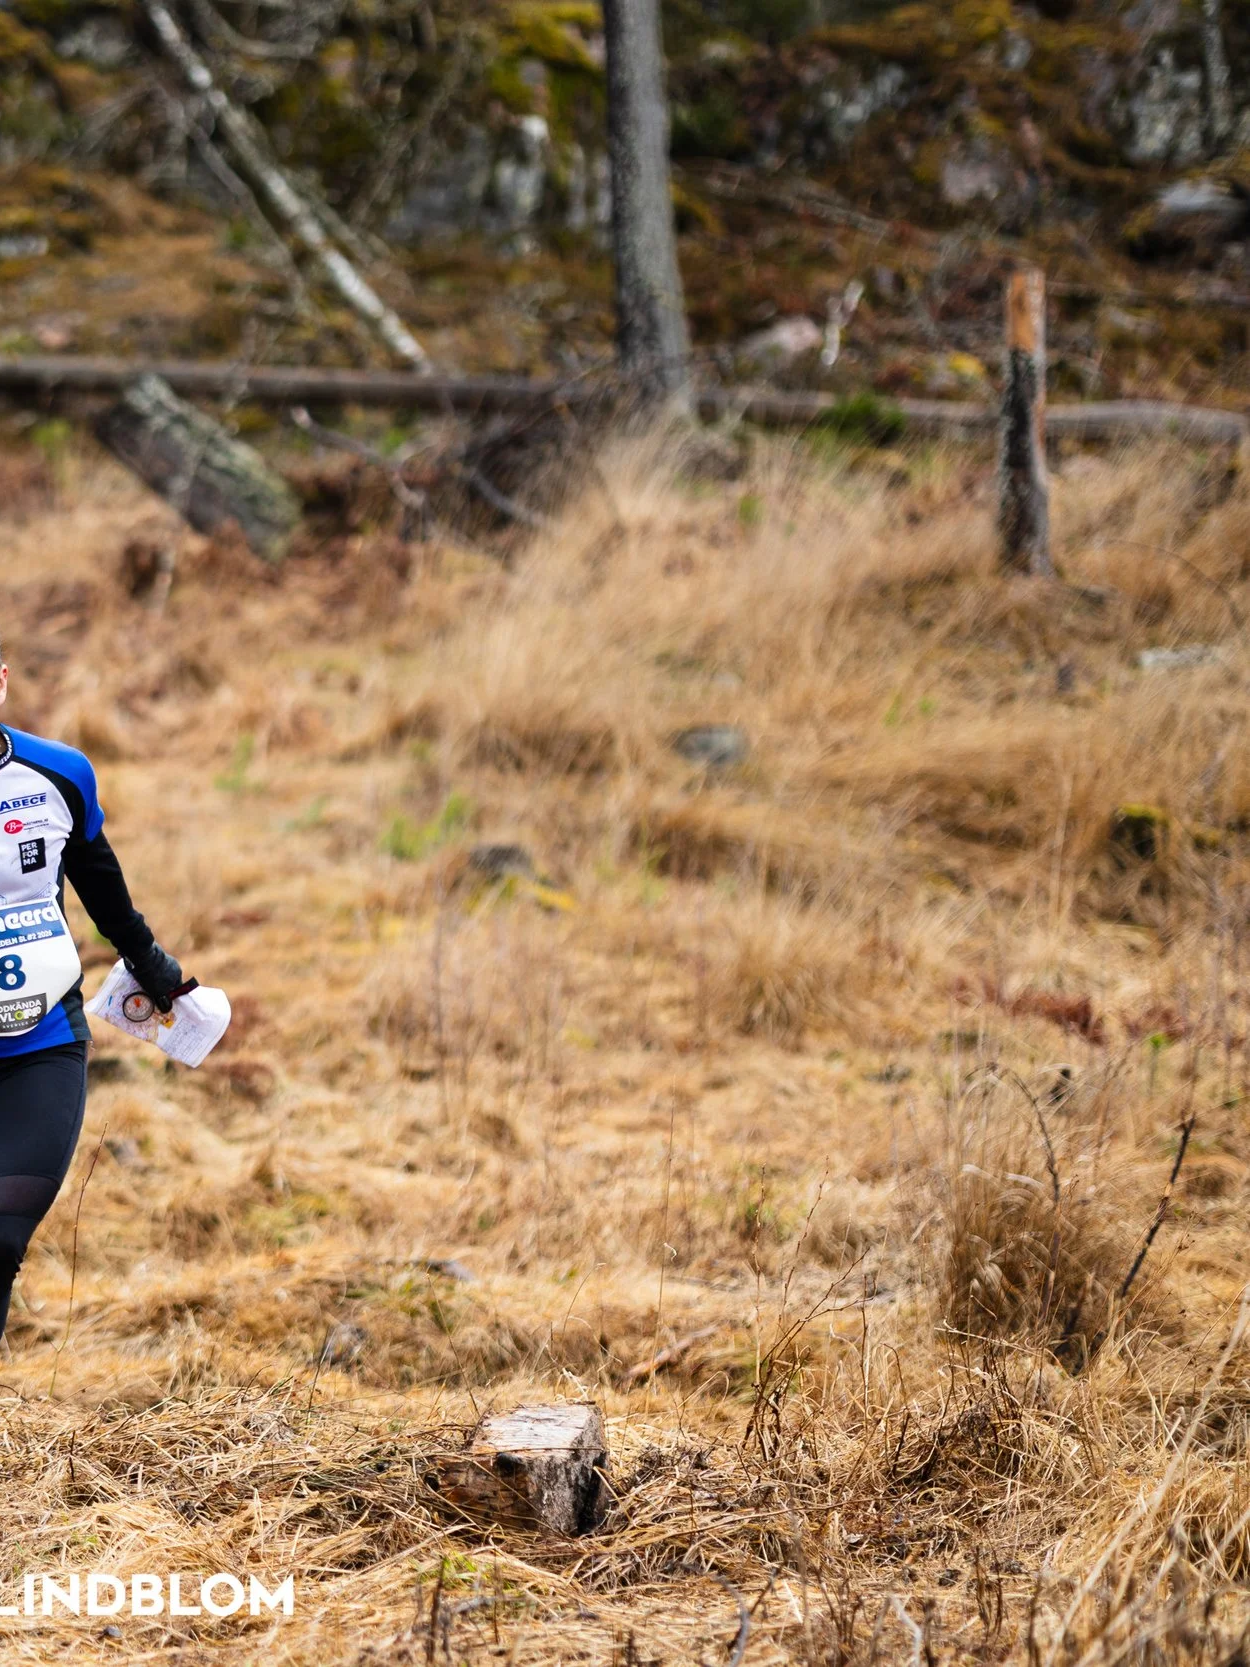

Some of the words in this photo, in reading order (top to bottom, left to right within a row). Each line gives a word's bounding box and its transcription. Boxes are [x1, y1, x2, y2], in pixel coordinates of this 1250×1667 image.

[0, 795, 46, 812] ABECE
[21, 842, 37, 852] PER
[22, 849, 39, 859] FOR
[23, 857, 37, 866] MA
